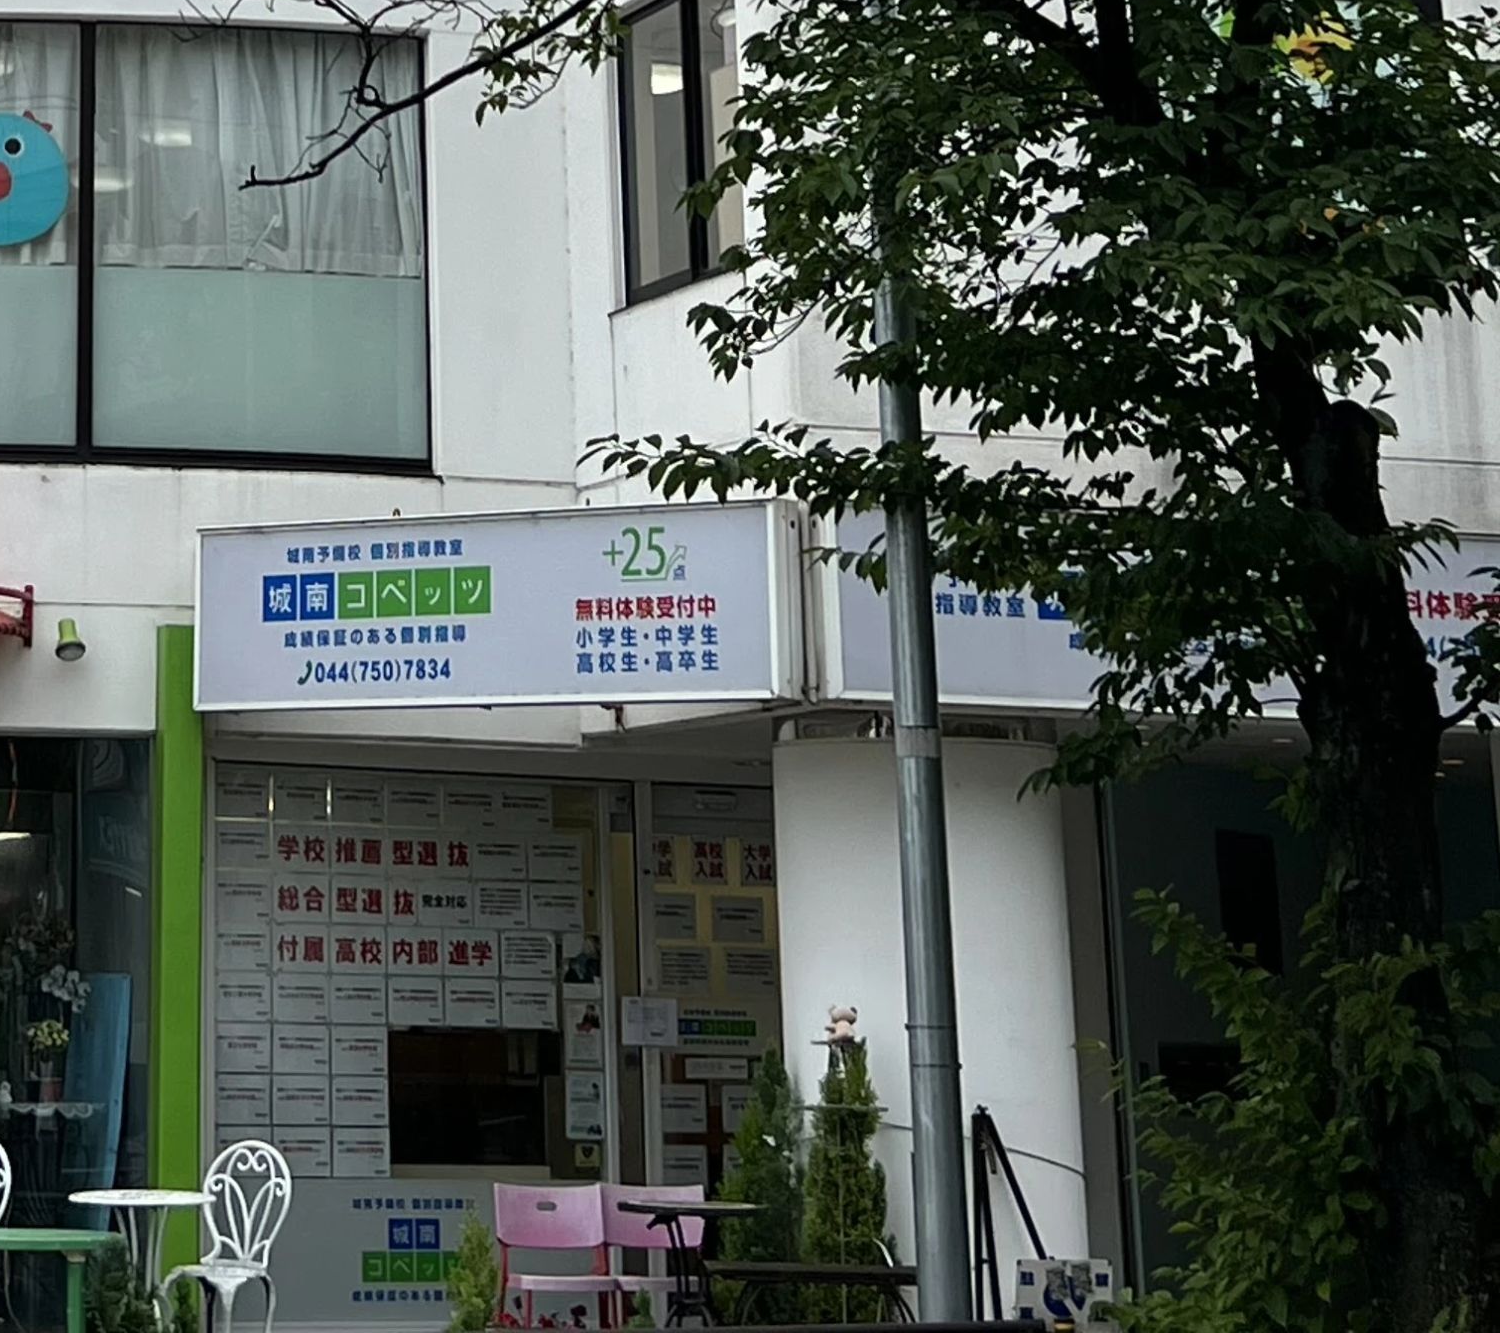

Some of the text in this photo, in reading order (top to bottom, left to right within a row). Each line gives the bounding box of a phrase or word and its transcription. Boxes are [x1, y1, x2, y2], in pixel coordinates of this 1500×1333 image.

[370, 539, 464, 561] 個別指導教室
[575, 593, 717, 621] 無料体験受付中
[283, 624, 467, 649] 成績保証のある個別指導
[575, 624, 719, 649] 小学生・中学生
[314, 658, 451, 684] 044(750)7834
[575, 649, 720, 674] 高校生・高卒生
[277, 834, 470, 867] 学校推薦型選抜
[277, 884, 415, 916] 総合型選抜
[277, 934, 493, 967] 付属高校内部進学
